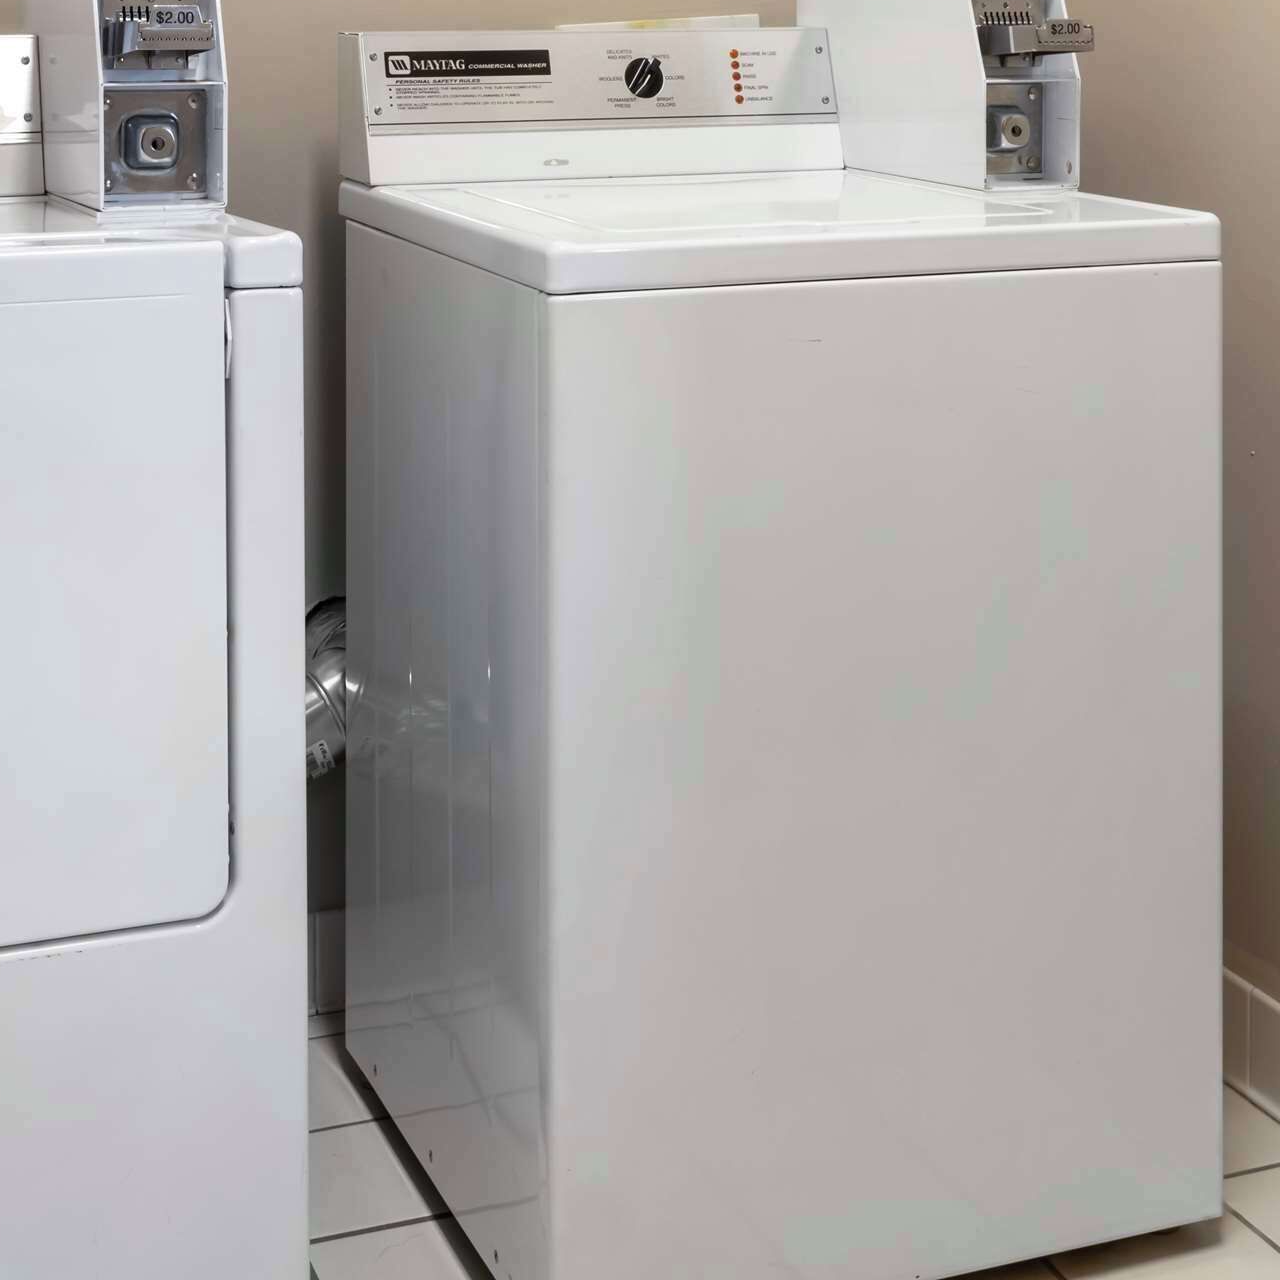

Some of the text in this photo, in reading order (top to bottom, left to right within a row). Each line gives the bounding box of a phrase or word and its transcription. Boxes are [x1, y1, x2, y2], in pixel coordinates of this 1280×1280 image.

[156, 11, 194, 24] $2.00
[1051, 23, 1080, 35] $2.00
[412, 59, 465, 71] MAYTAG
